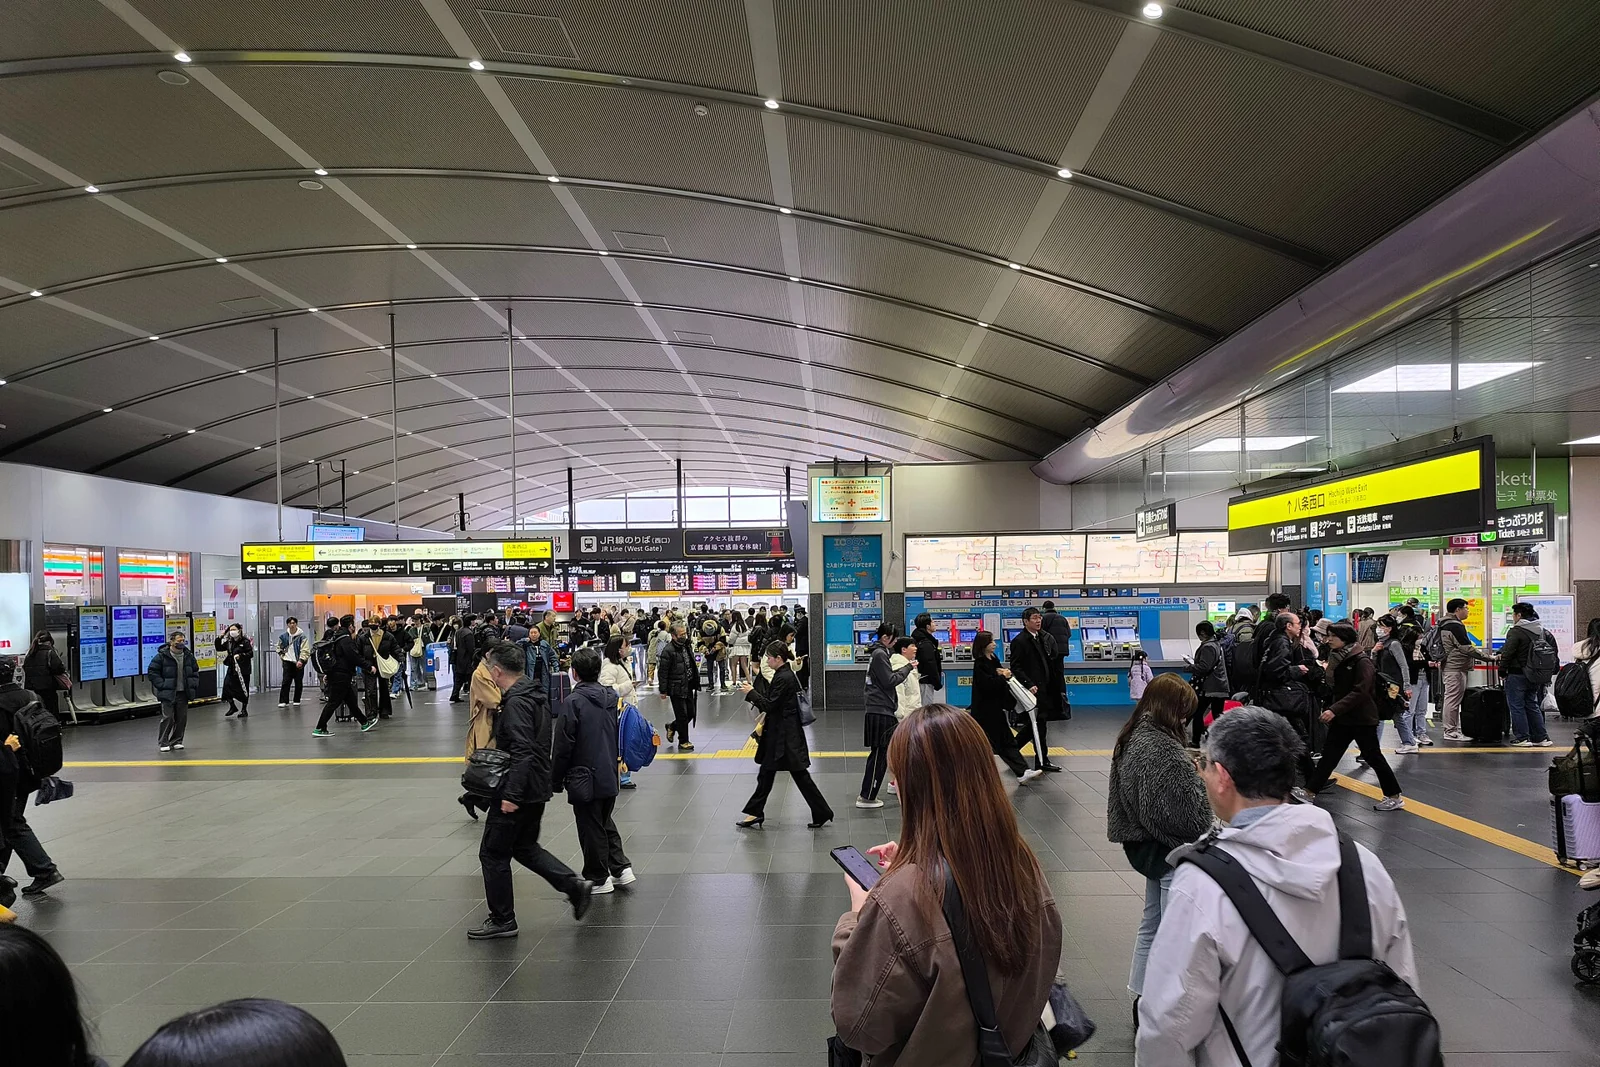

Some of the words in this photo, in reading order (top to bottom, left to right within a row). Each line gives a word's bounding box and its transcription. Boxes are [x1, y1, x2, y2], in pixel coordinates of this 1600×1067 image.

[1346, 485, 1358, 496] West
[1358, 483, 1368, 494] Exit
[1293, 493, 1325, 512] 八条西口
[1497, 511, 1544, 528] きっぷうりば
[1318, 520, 1336, 530] タクシー
[1498, 529, 1515, 539] Tickets
[624, 545, 643, 553] (West
[644, 545, 663, 553] Gate)
[828, 601, 877, 609] JR近距離きっぷ
[971, 599, 1032, 607] JR近距離きっぷ
